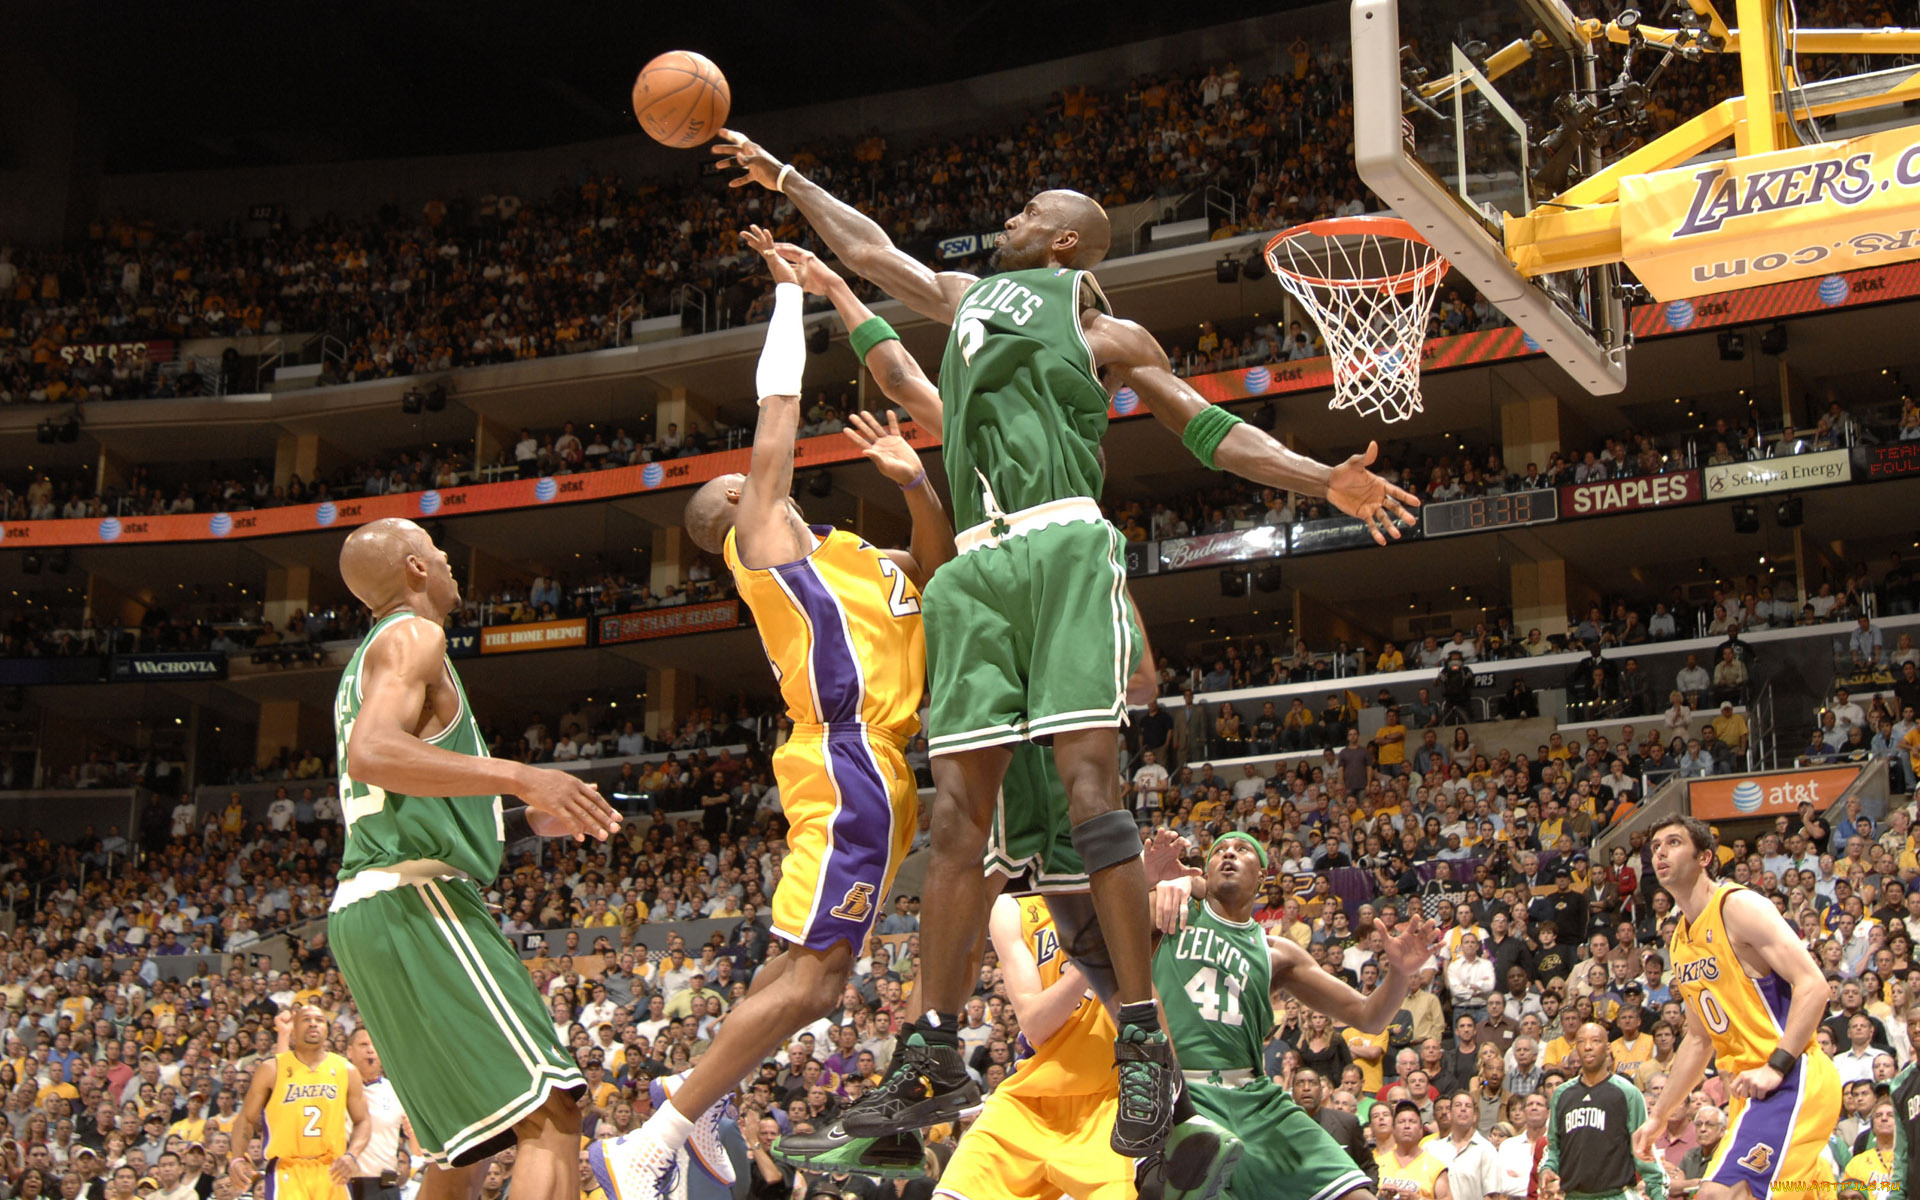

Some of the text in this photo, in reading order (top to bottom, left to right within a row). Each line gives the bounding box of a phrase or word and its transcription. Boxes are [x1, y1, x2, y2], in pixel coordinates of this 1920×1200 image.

[943, 238, 972, 255] FSN
[1852, 276, 1886, 293] at&t
[955, 278, 1043, 326] LTICS
[1697, 300, 1730, 317] at&t
[957, 308, 995, 367] 5
[1731, 461, 1844, 490] Sempra Energy
[1574, 475, 1687, 513] STAPLES
[1470, 494, 1531, 528] 8:38
[878, 557, 922, 618] 2
[484, 626, 584, 647] THE HOME DEPOT
[134, 661, 217, 674] WACHOVIA
[1769, 779, 1820, 805] at&t
[527, 935, 542, 949] 119
[1184, 966, 1245, 1027] 41
[282, 1083, 338, 1104] LAKERS
[303, 1105, 322, 1137] 2
[1565, 1107, 1606, 1134] BOSTON
